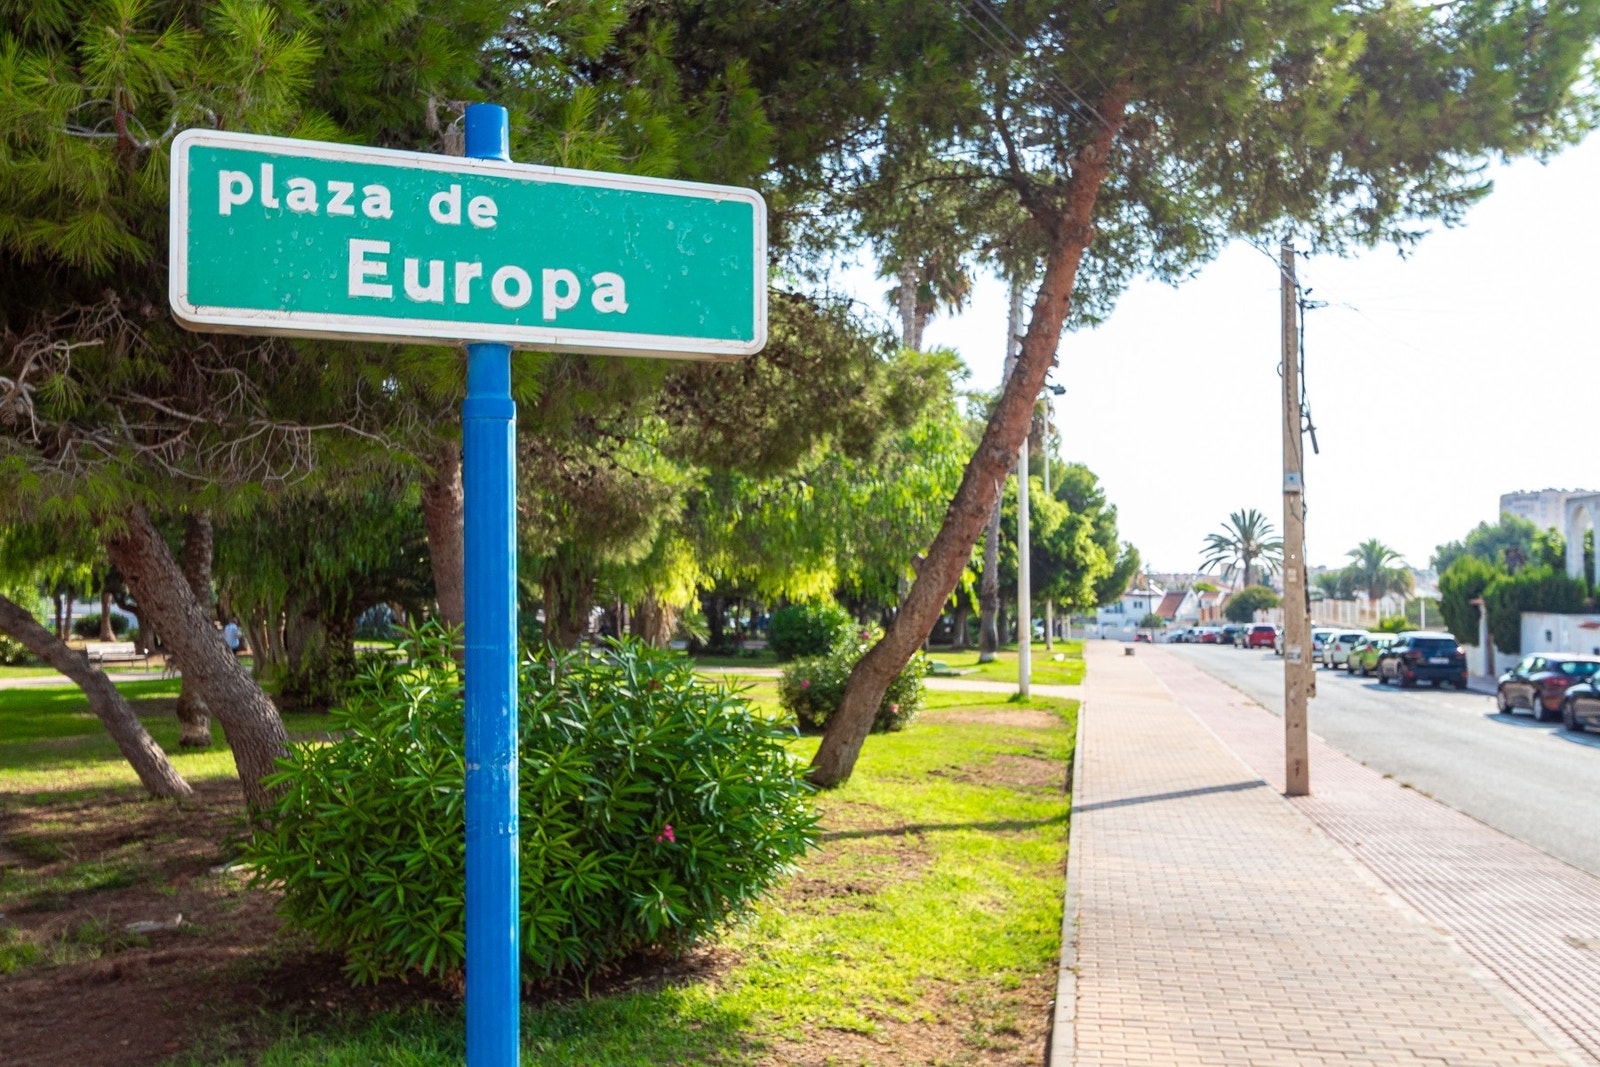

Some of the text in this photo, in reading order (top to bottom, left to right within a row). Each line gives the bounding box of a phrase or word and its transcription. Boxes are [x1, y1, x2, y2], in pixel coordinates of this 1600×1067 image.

[219, 164, 498, 228] plaza de
[348, 239, 629, 320] Europa
